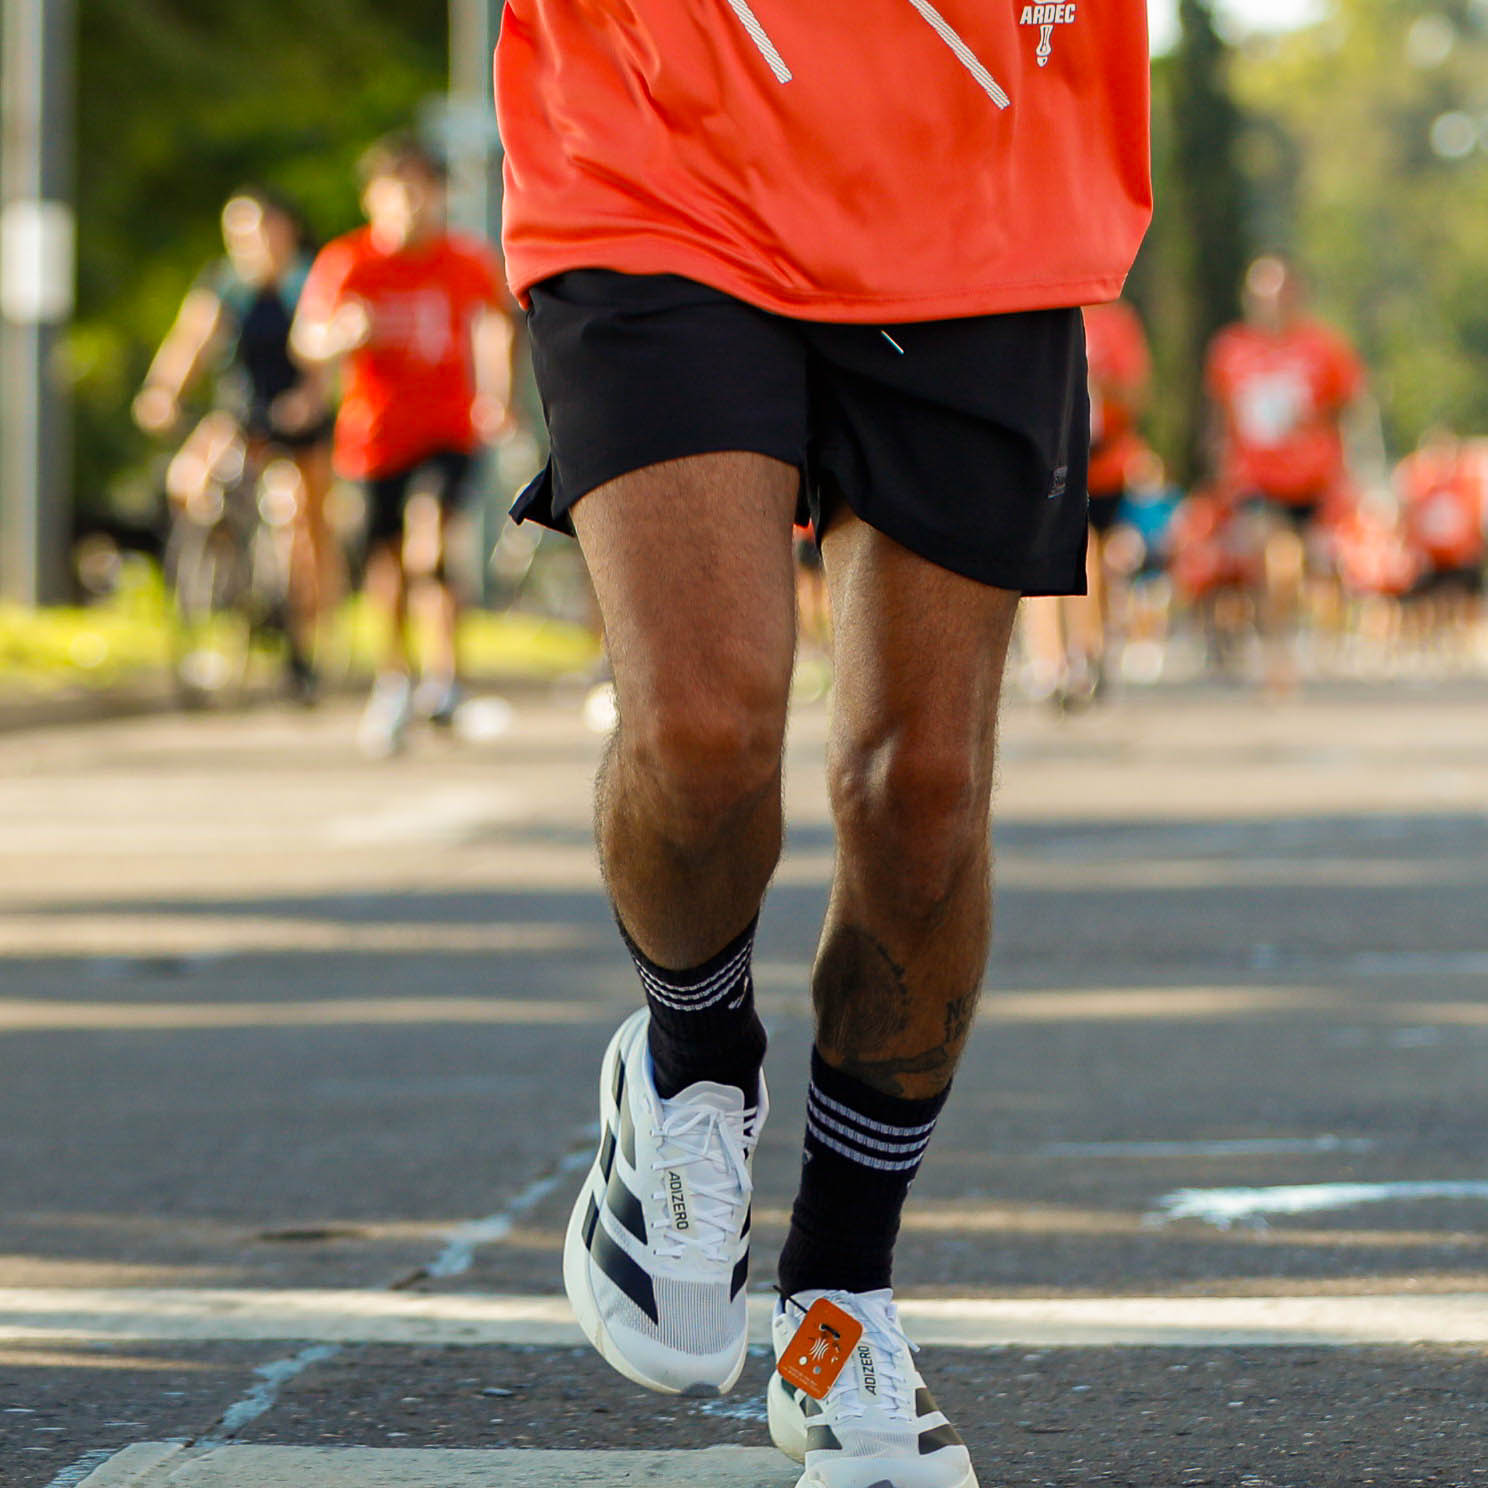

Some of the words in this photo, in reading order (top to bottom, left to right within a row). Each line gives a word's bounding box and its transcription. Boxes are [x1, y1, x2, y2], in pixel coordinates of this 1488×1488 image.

[1019, 4, 1076, 25] ARDEC
[668, 1170, 689, 1231] ADIZERO
[857, 1345, 877, 1396] ADIZERO
